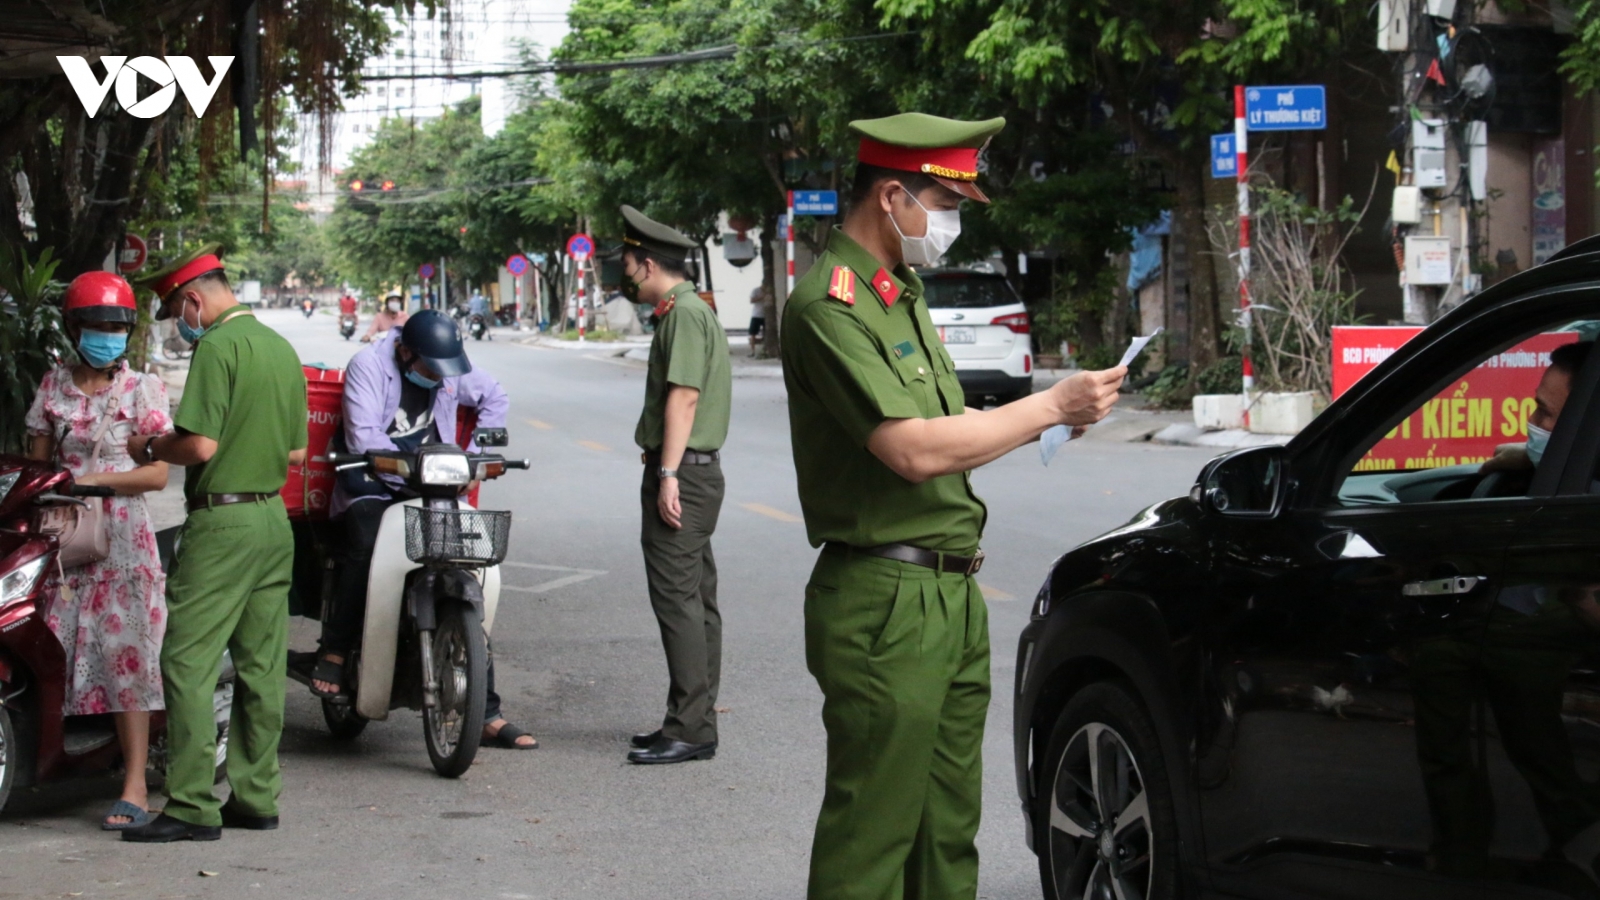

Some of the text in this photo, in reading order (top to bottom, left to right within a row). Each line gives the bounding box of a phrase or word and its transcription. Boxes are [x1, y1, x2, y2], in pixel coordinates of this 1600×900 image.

[1301, 107, 1321, 124] KIỆT
[1422, 381, 1493, 438] KIỂM
[2, 616, 31, 633] HONDA
